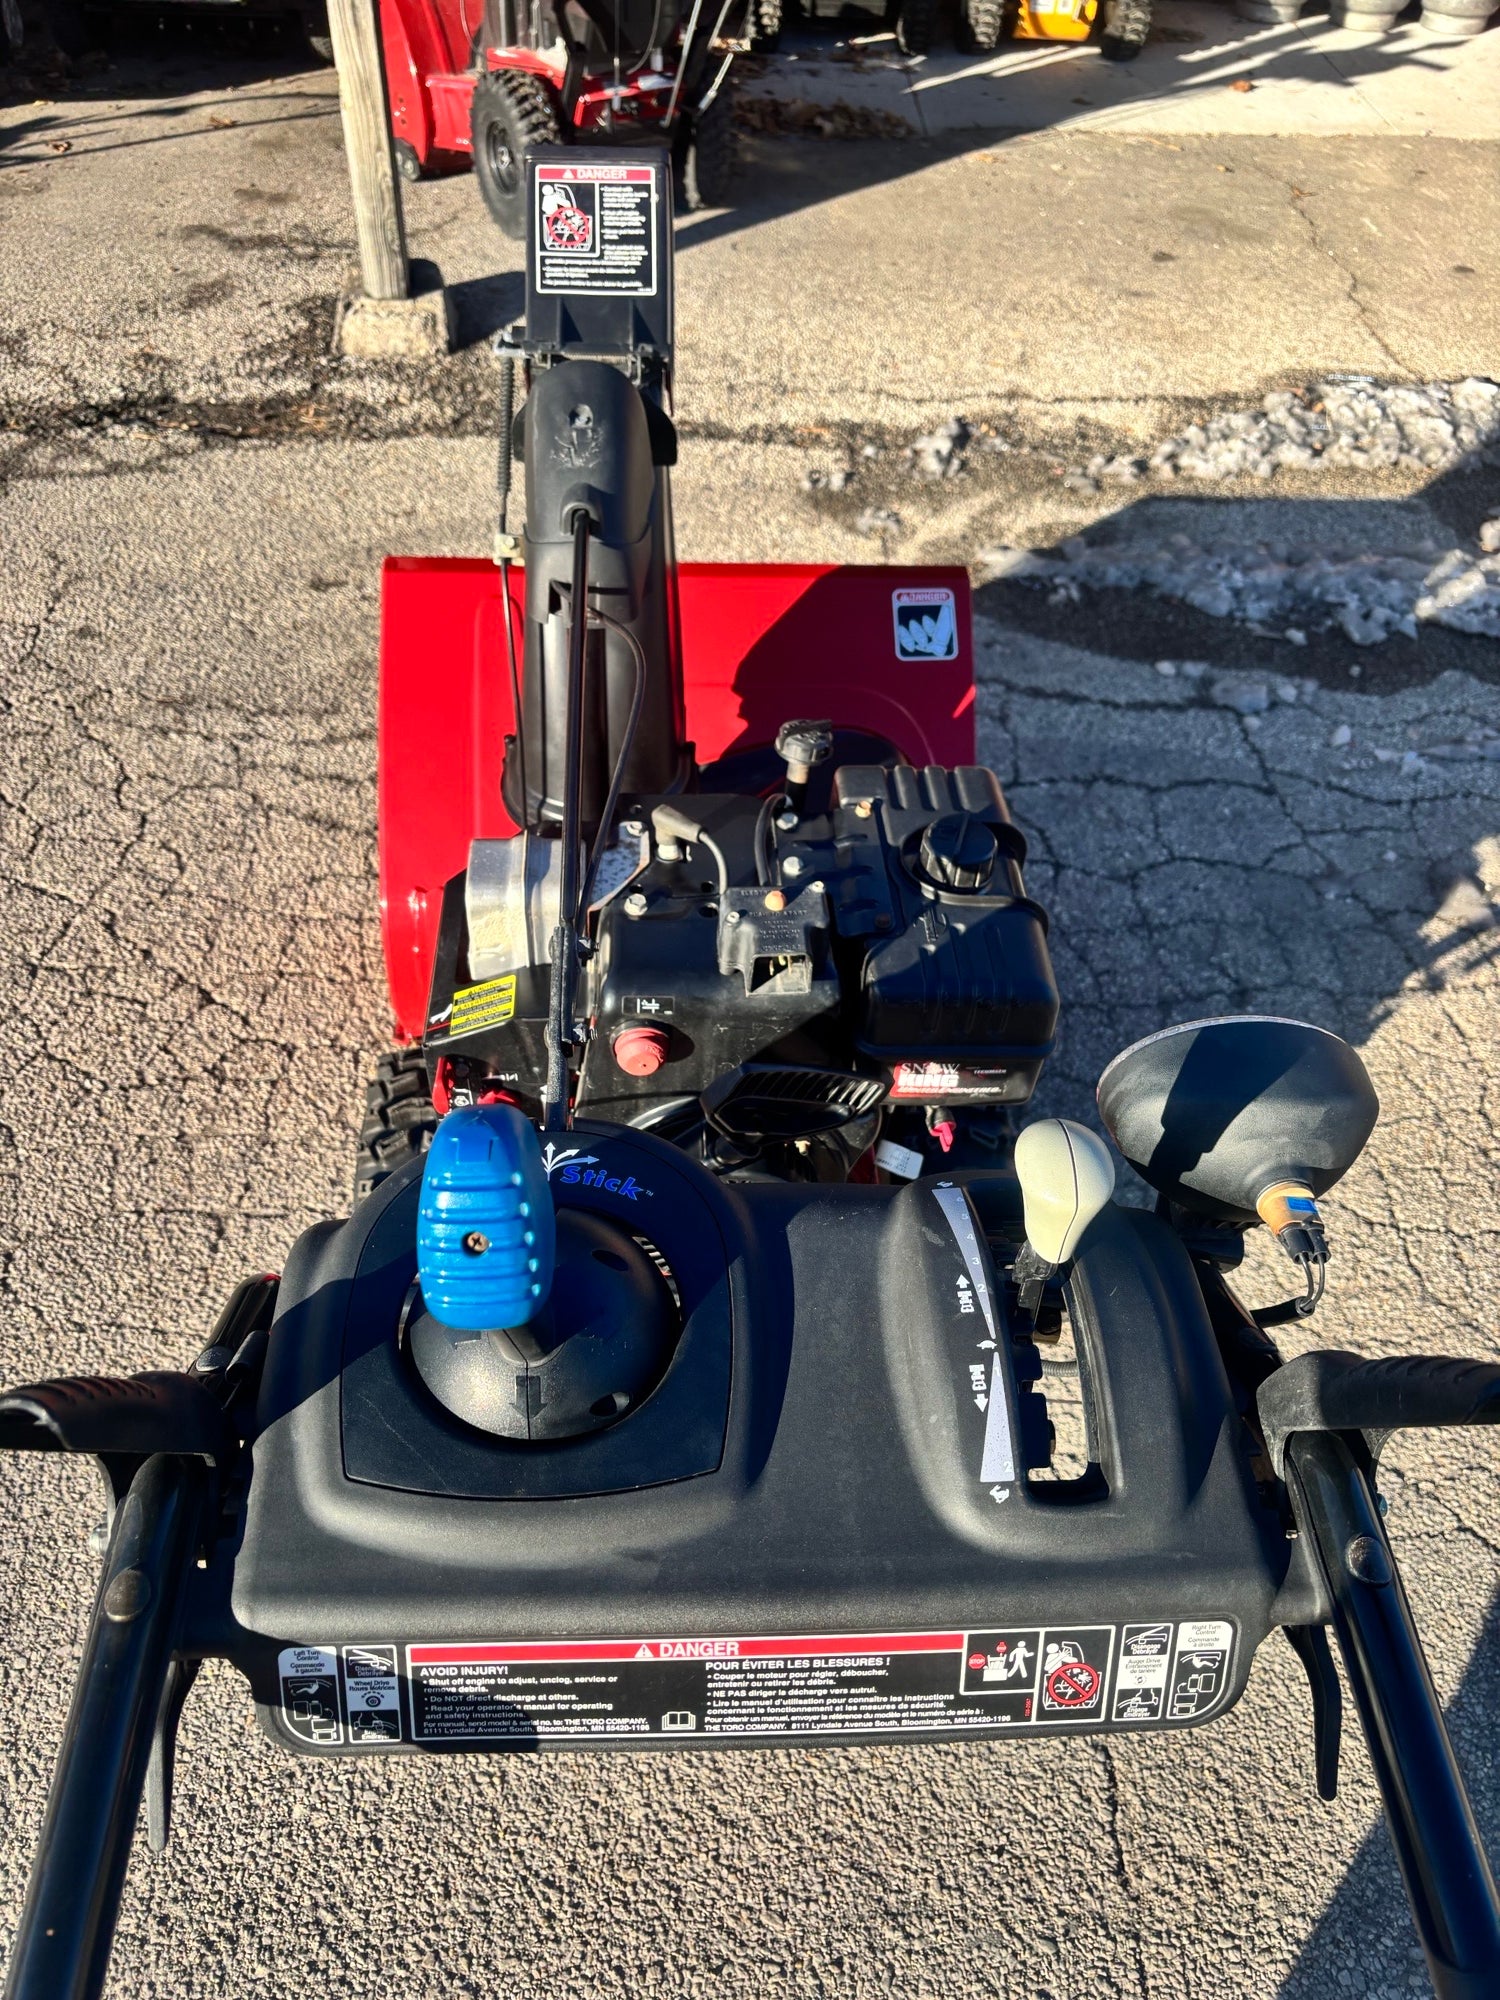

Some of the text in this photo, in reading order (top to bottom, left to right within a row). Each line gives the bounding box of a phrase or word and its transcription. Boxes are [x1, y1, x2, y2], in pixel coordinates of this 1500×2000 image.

[576, 169, 627, 180] DANGER
[898, 1074, 959, 1087] KING
[560, 1165, 644, 1200] Stick
[660, 1641, 739, 1657] DANGER
[706, 1658, 884, 1670] POUR ÉVITER LES BLESSURES
[420, 1666, 508, 1676] AVOID INJURY!
[713, 1673, 745, 1681] Couper
[840, 1668, 889, 1677] déboucher,
[428, 1678, 450, 1686] Shut
[465, 1677, 495, 1687] engine
[508, 1677, 538, 1685] adjust,
[493, 1694, 536, 1702] discharge
[748, 1689, 777, 1698] diriger
[788, 1688, 828, 1696] décharge
[826, 1697, 847, 1705] pour
[571, 1702, 613, 1711] operating
[707, 1707, 756, 1715] concernant
[767, 1705, 833, 1713] fonctionnement
